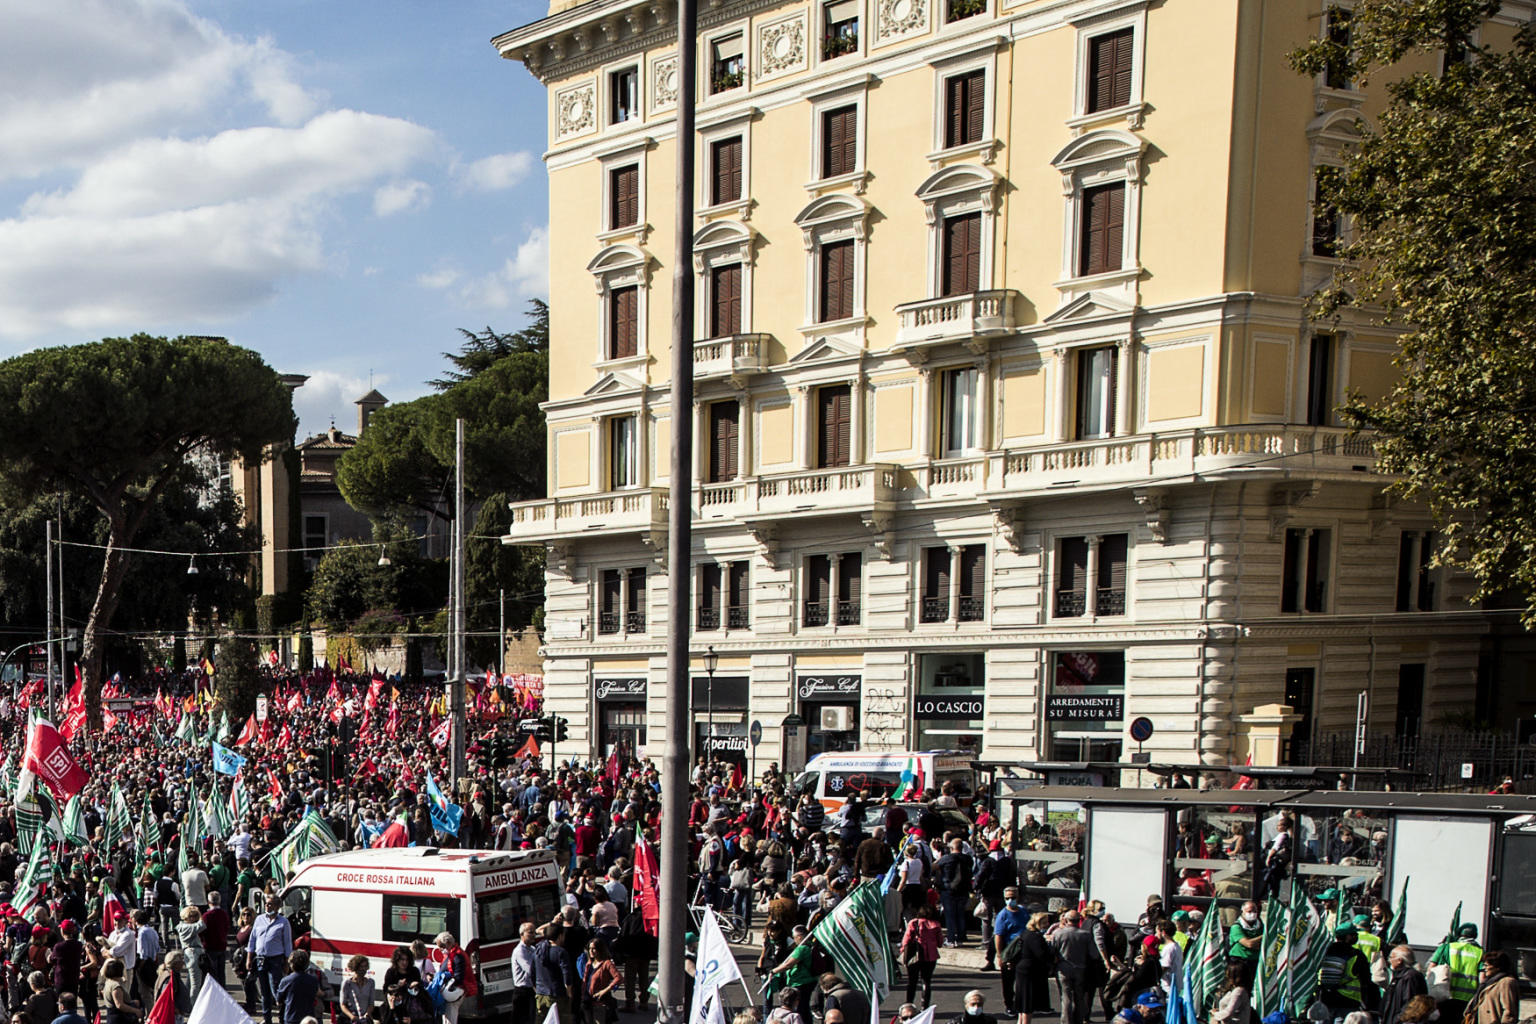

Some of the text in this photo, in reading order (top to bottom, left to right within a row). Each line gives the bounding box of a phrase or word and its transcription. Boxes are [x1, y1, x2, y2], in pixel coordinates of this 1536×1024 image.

[799, 677, 835, 697] Fusion
[916, 702, 983, 713] LO CASCIO
[1050, 698, 1114, 707] ARREDAMENTI
[1049, 709, 1114, 717] SU MISURA
[50, 753, 66, 773] SPI
[337, 872, 436, 887] CROCE ROSSA ITALIANA
[485, 867, 549, 889] AMBULANZA
